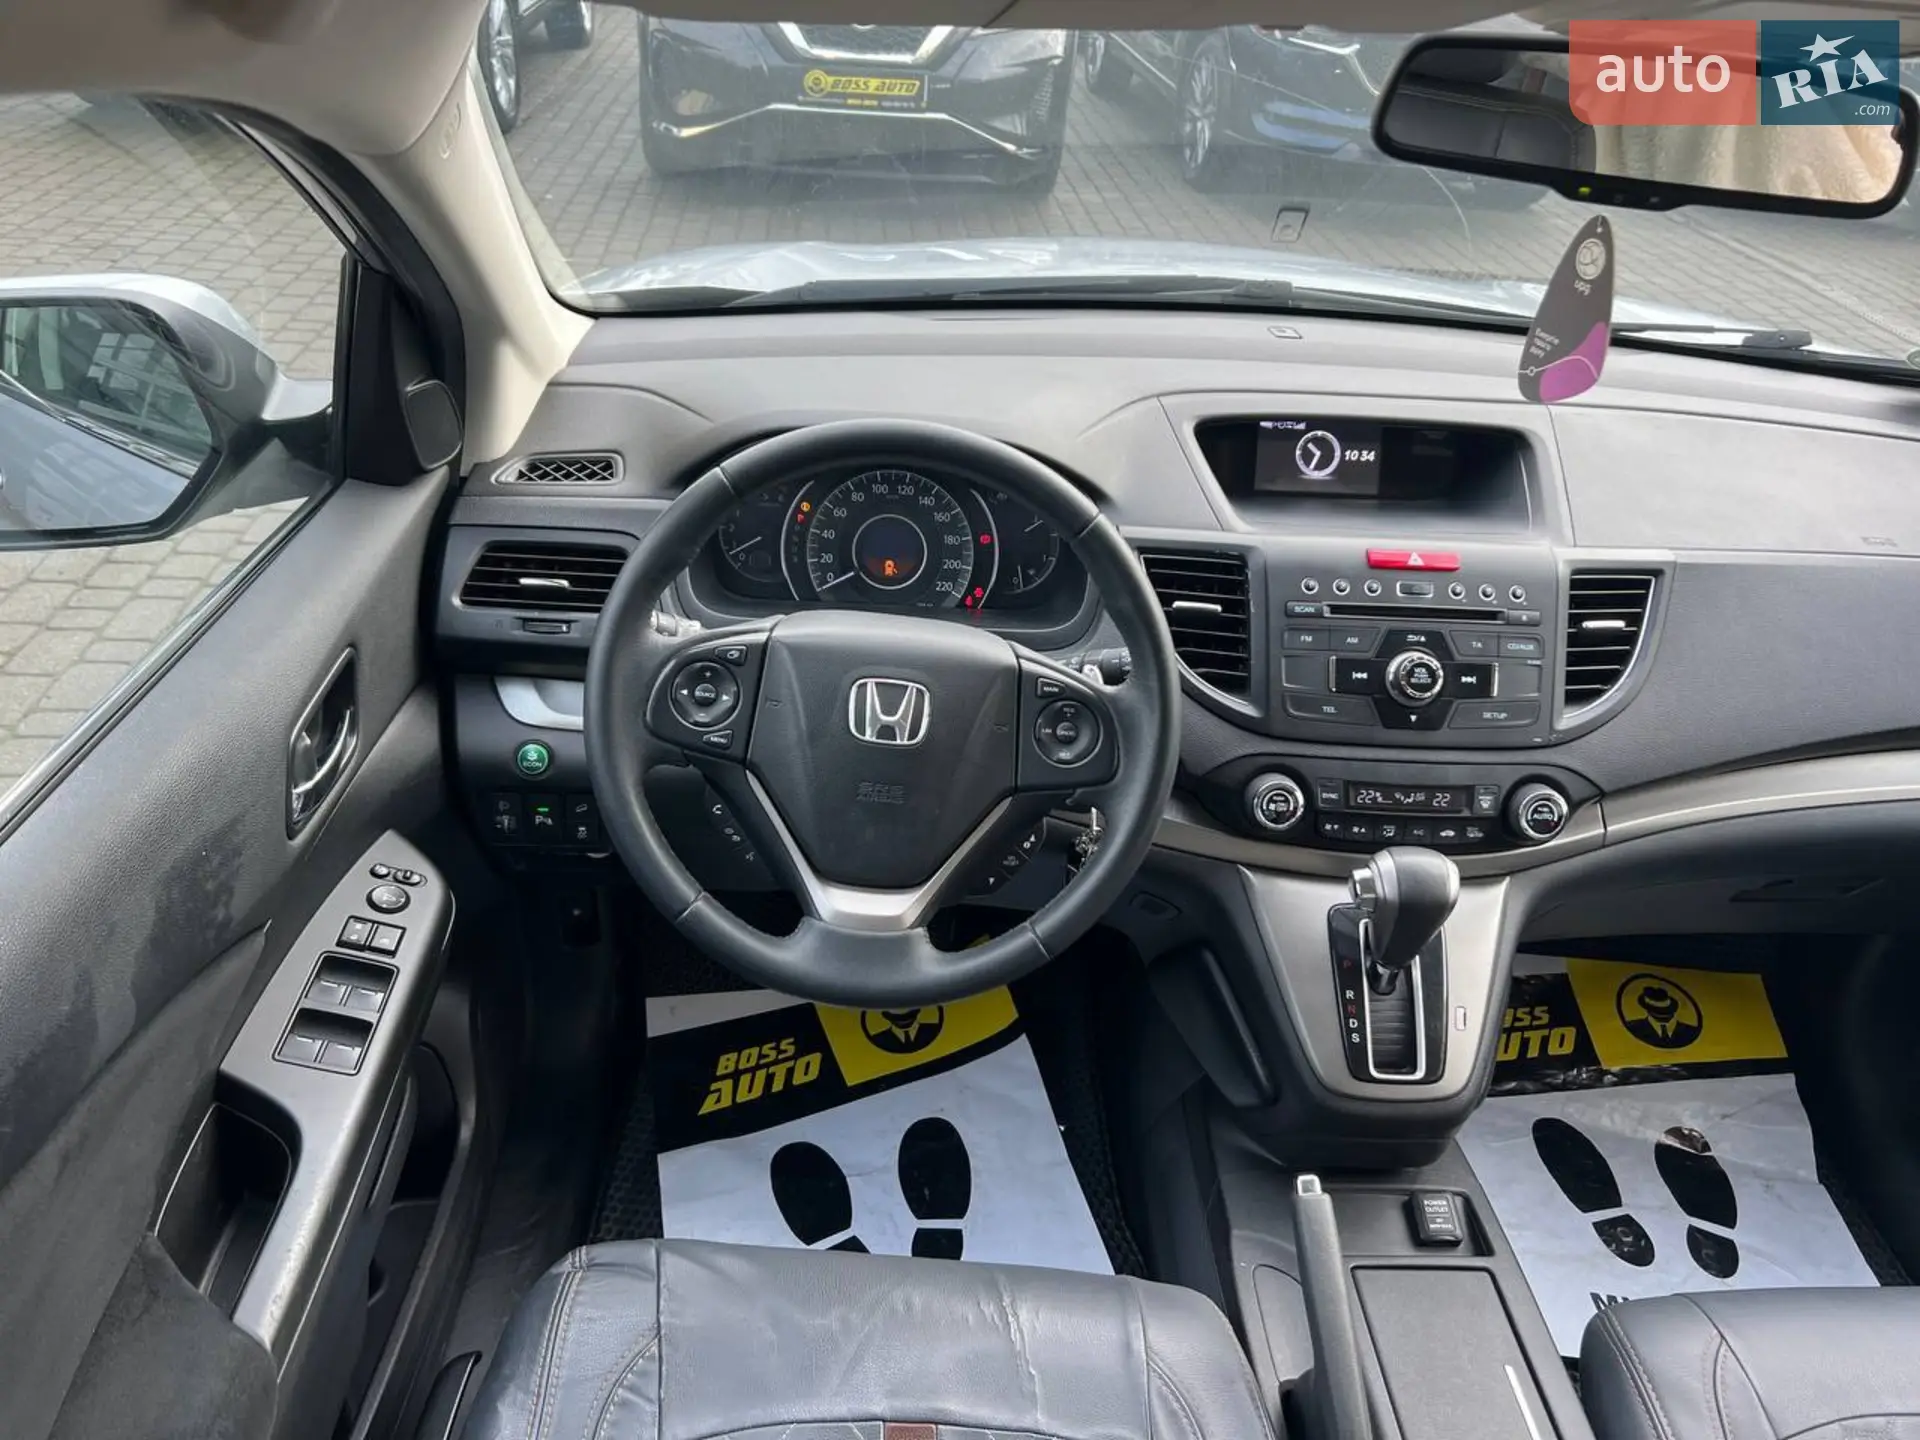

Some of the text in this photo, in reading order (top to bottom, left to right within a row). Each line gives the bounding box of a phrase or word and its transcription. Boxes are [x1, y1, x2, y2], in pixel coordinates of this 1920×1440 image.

[871, 484, 889, 494] 100
[897, 485, 915, 495] 120
[851, 492, 865, 502] 80
[918, 496, 935, 506] 140
[833, 507, 847, 517] 60
[933, 512, 951, 522] 160
[821, 529, 835, 539] 40
[944, 534, 961, 545] 180
[819, 553, 833, 563] 20
[942, 559, 962, 569] 200
[826, 572, 834, 582] 0
[935, 581, 953, 592] 220
[1300, 635, 1313, 643] FM
[1346, 636, 1360, 644] AM
[1432, 792, 1452, 807] 22
[1346, 990, 1355, 999] R
[1349, 1018, 1358, 1028] D
[1351, 1033, 1360, 1043] S
[1496, 1026, 1577, 1062] UTO
[715, 1038, 796, 1077] BOSS
[697, 1051, 823, 1117] AUTO
